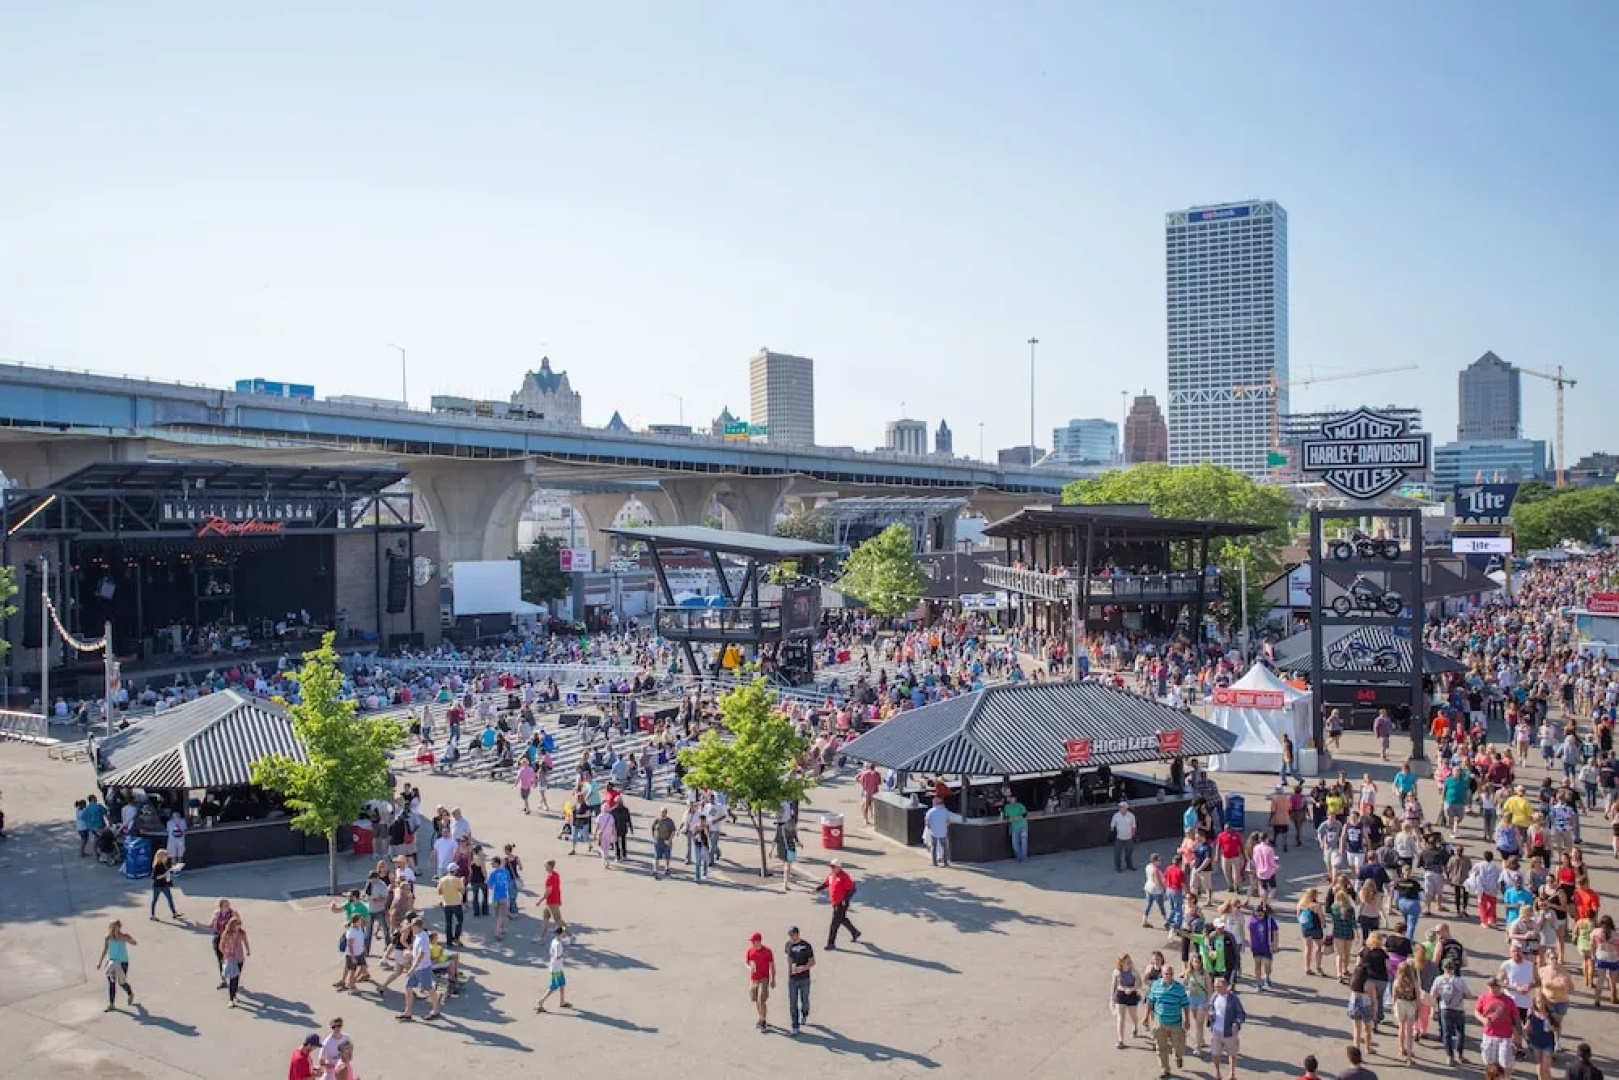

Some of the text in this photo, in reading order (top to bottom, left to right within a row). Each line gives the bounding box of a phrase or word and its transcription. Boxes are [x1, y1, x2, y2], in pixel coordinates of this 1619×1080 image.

[1334, 418, 1393, 439] MOTOR
[1309, 443, 1419, 464] HARLEY-DAVIDSON
[1333, 469, 1393, 492] CYCLES
[1461, 487, 1505, 513] Lite
[1092, 737, 1127, 754] HIGH
[1128, 735, 1158, 750] LIFE
